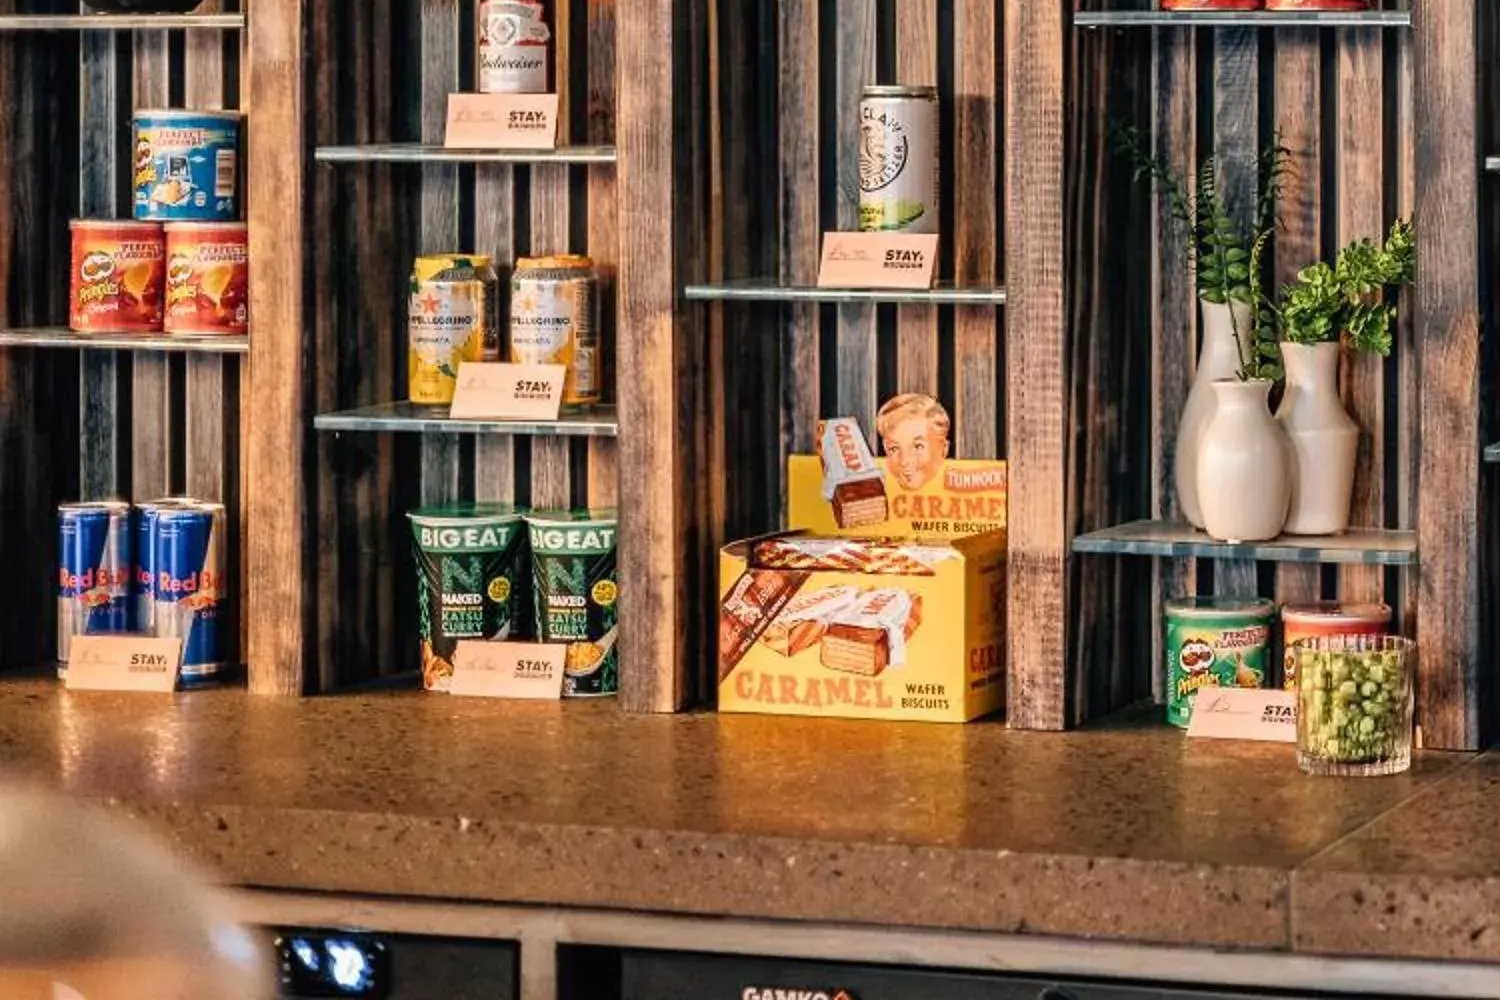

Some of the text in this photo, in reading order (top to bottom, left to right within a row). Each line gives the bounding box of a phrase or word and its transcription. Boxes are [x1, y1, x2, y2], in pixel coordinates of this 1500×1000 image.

[891, 494, 1005, 520] CARAME
[911, 520, 949, 532] WAFER
[421, 527, 510, 548] BIG EAT
[530, 529, 614, 549] BIG EAT
[60, 568, 93, 588] Red
[159, 571, 196, 592] Red
[441, 593, 483, 604] NAKED
[548, 595, 586, 607] NAKED
[735, 672, 894, 709] CARAMEL
[905, 683, 945, 696] WAFER
[901, 697, 950, 710] BISCUITS
[1263, 705, 1297, 717] STA
